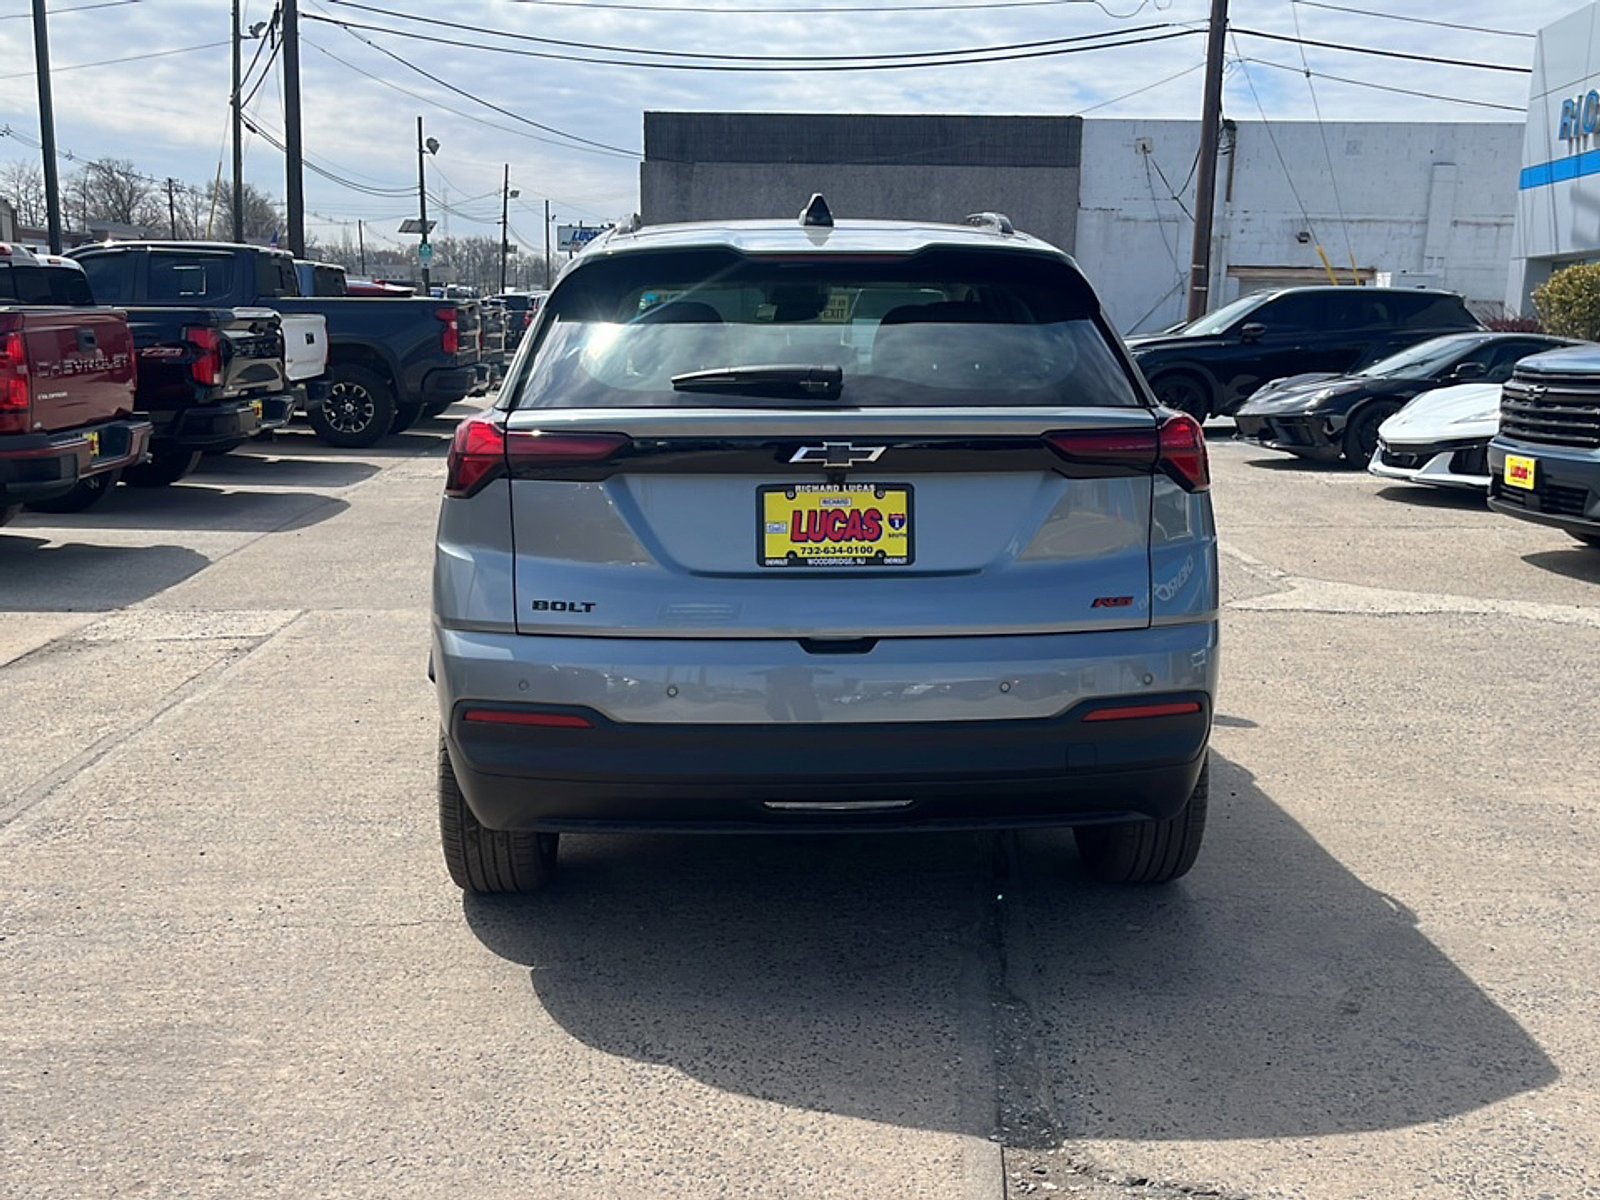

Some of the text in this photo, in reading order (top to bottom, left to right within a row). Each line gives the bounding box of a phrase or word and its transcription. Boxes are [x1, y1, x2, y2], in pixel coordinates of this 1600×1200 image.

[795, 484, 876, 493] RICHARD LUCAS
[790, 508, 884, 543] LUCAS
[800, 546, 874, 555] 732-634-0100
[531, 600, 597, 613] BOLT
[1091, 596, 1134, 608] RS
